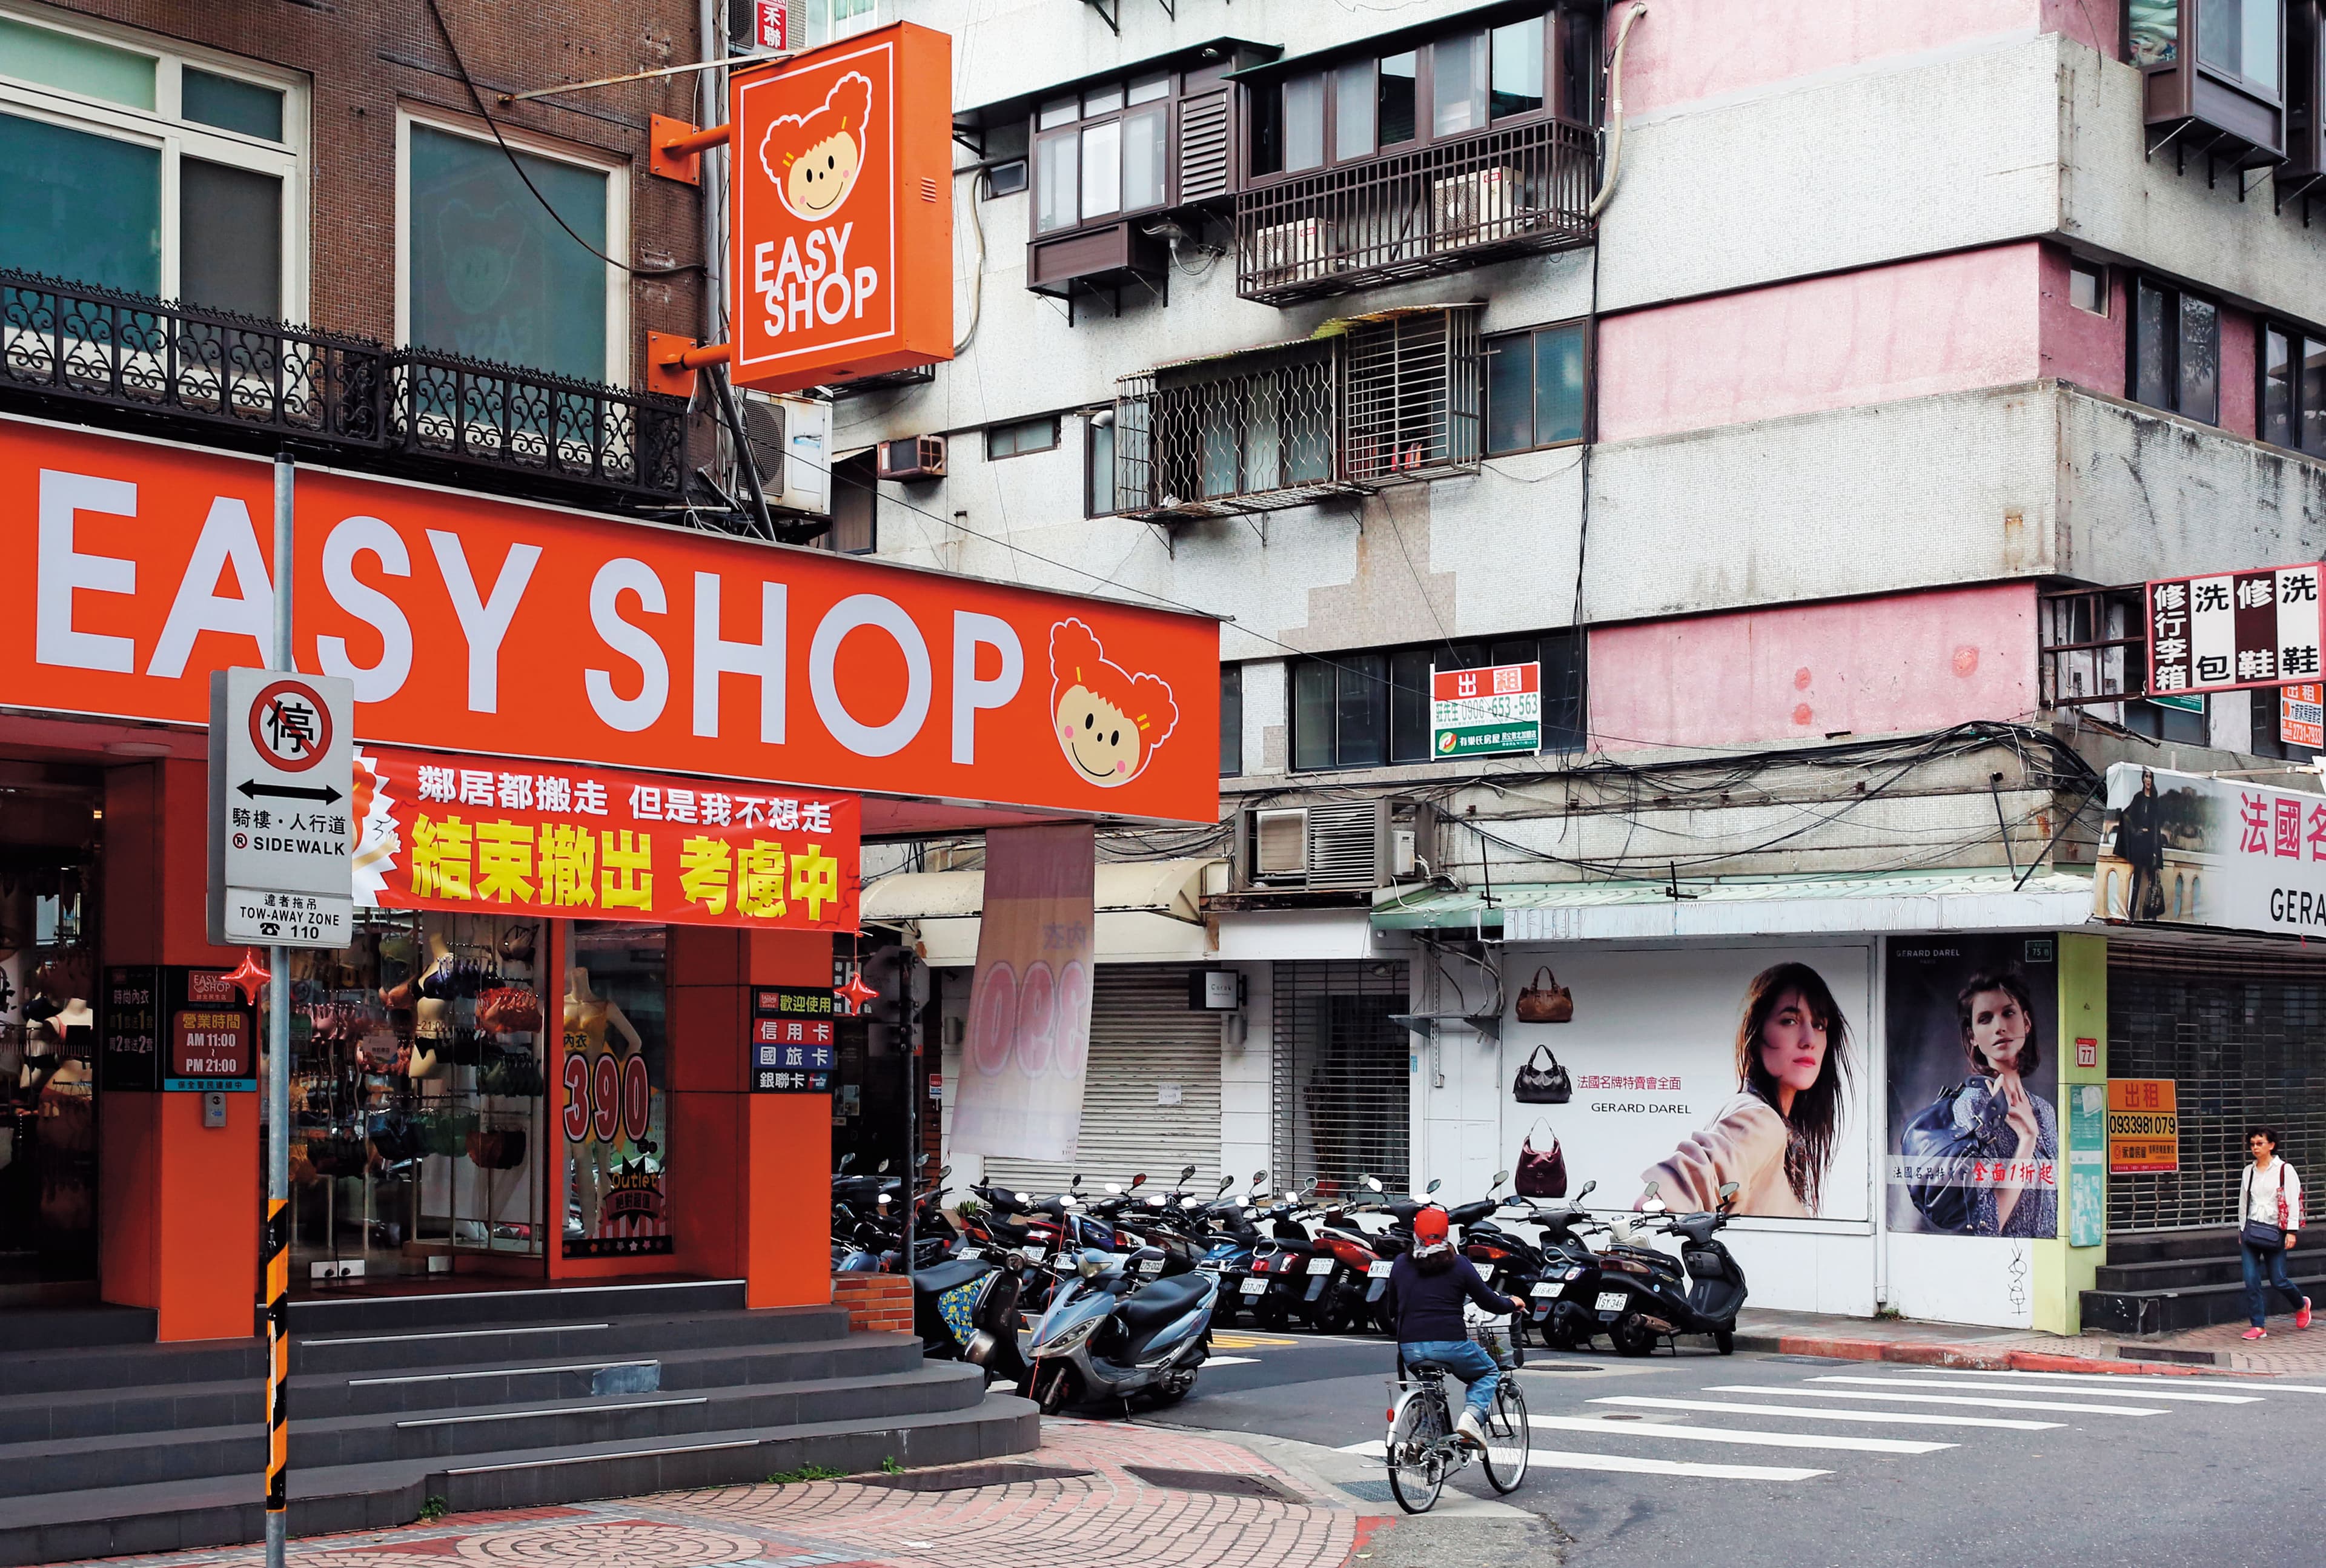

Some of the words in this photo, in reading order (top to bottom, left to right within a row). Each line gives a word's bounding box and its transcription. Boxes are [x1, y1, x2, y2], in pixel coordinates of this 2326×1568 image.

[763, 5, 781, 48] 禾聯
[755, 222, 853, 293] EASY
[764, 266, 878, 337] SHOP
[36, 469, 543, 713] EASY
[585, 558, 1024, 765] SHOP
[2281, 574, 2319, 675] 洗鞋
[2153, 584, 2187, 691] 修行李箱
[2195, 584, 2230, 682] 洗包
[2236, 579, 2275, 680] 修鞋
[1458, 667, 1520, 696] 出租
[2287, 685, 2315, 701] 出租
[267, 700, 314, 753] 停
[1460, 733, 1501, 746] 有巢氏房屋
[418, 766, 608, 815] 鄰居都搬走
[629, 785, 832, 833] 但是我不想走
[2240, 792, 2326, 861] 法國名
[254, 836, 345, 856] SIDEWALK
[411, 813, 654, 911] 結束撤出
[679, 836, 838, 922] 考慮中
[264, 893, 317, 910] 違者拖吊
[240, 907, 303, 924] TOW-AWAY
[309, 913, 339, 925] ZONE
[291, 925, 319, 939] 110
[194, 974, 217, 984] EASY
[204, 982, 230, 992] SHOP
[113, 989, 149, 1004] 時尚內衣
[780, 995, 830, 1013] 歡迎使用
[183, 1013, 240, 1029] 營業時間
[187, 1033, 204, 1047] AM
[207, 1033, 236, 1047] 11:00
[563, 1033, 588, 1048] 內衣
[761, 1021, 830, 1042] 信用卡
[186, 1059, 204, 1072] PM
[206, 1059, 236, 1072] 21:00
[760, 1047, 828, 1066] 國旅卡
[2081, 1050, 2092, 1063] 77
[760, 1072, 805, 1088] 銀聯卡
[1577, 1075, 1682, 1091] 法國名牌特賣會全面
[563, 1052, 653, 1143] 390
[2125, 1083, 2159, 1108] 出租
[1591, 1102, 1645, 1114] GERARD
[1649, 1103, 1692, 1114] DAREL
[2109, 1115, 2176, 1134] 0933981079
[612, 1171, 658, 1189] Outlet
[1972, 1162, 2055, 1185] 全面1折起
